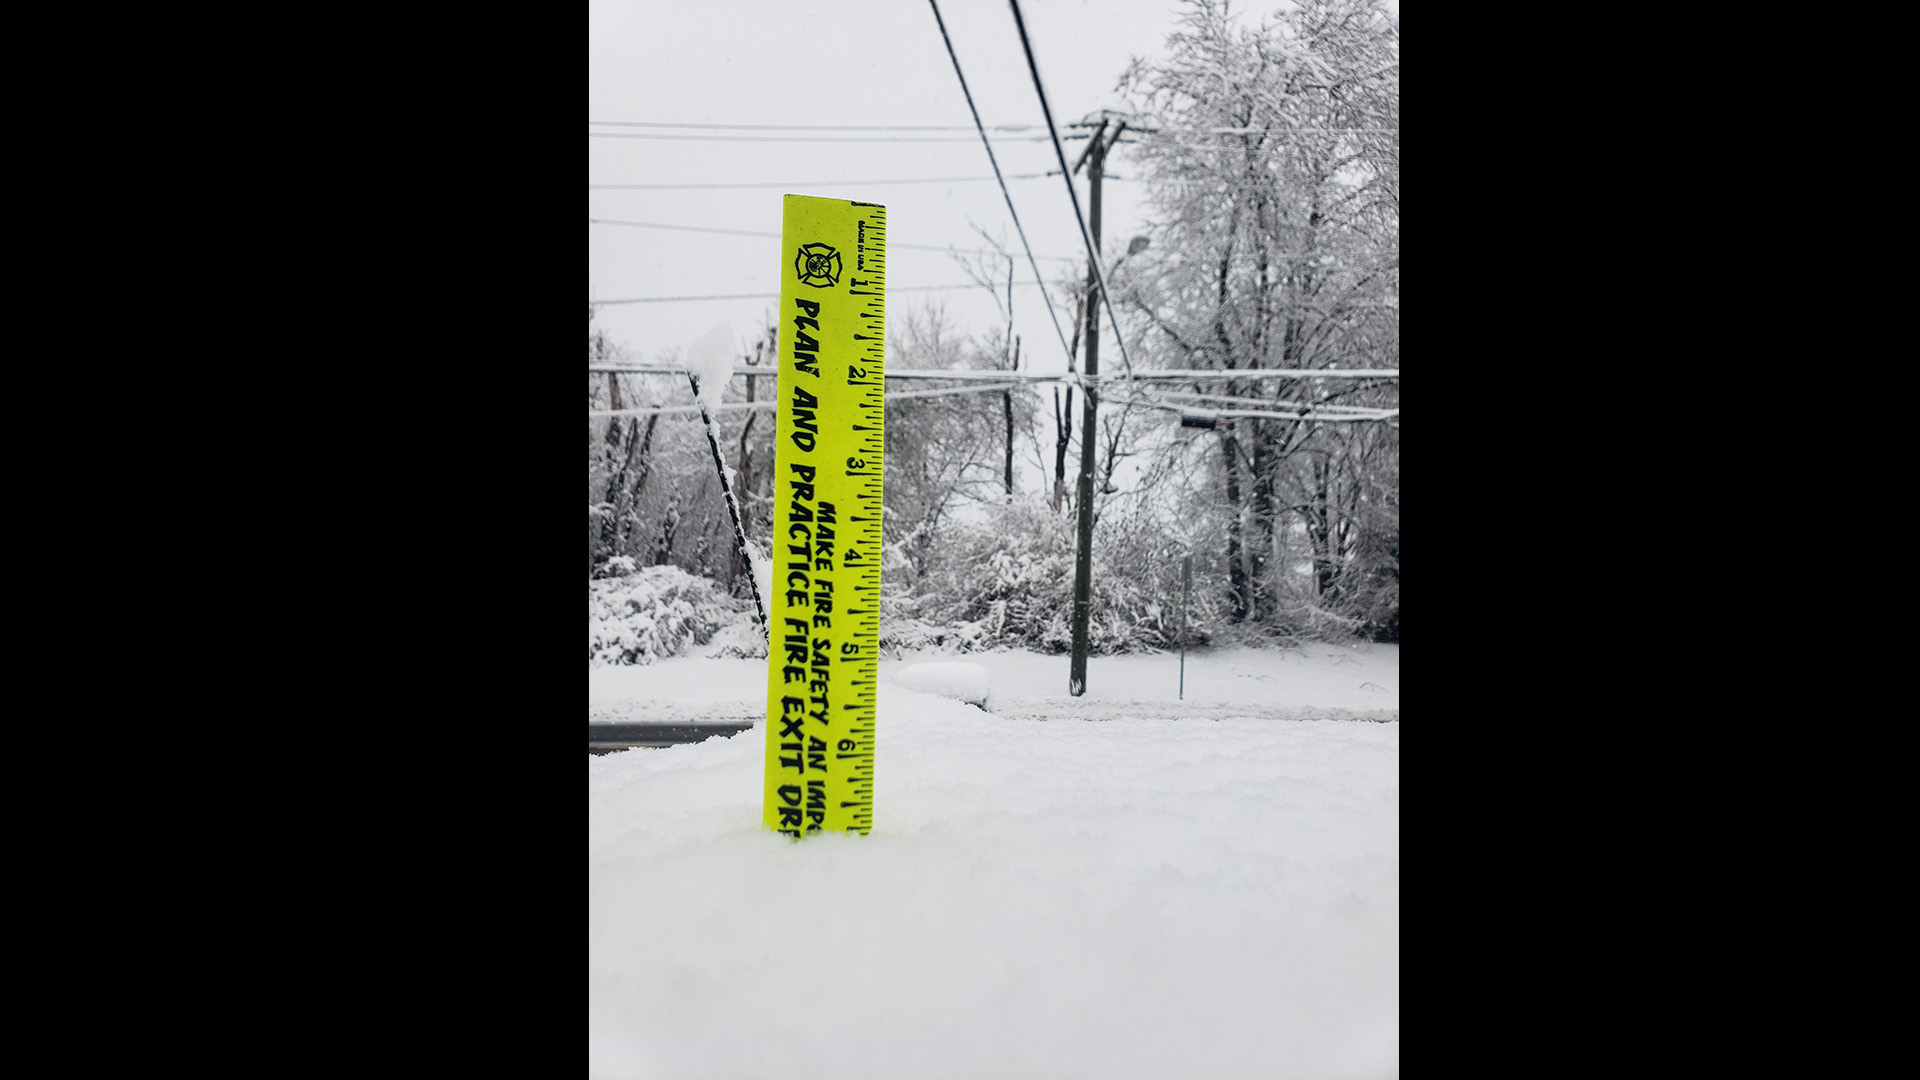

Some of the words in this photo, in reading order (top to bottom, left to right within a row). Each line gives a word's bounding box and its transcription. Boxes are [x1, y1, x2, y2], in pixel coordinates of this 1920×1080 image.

[857, 244, 864, 252] IN
[850, 277, 868, 287] 1
[793, 298, 820, 378] PLAN
[848, 365, 866, 379] 2
[791, 386, 818, 452] AND
[846, 456, 865, 469] 3
[785, 463, 816, 608] PRACTICE
[814, 501, 837, 572] MAKE
[844, 548, 862, 561] 4
[813, 579, 834, 628] FIRE
[782, 617, 809, 684] FIRE
[841, 642, 859, 655] 5
[809, 637, 831, 726] SAFETY
[779, 695, 805, 775] EXIT
[808, 735, 827, 773] AN
[837, 738, 856, 751] 6
